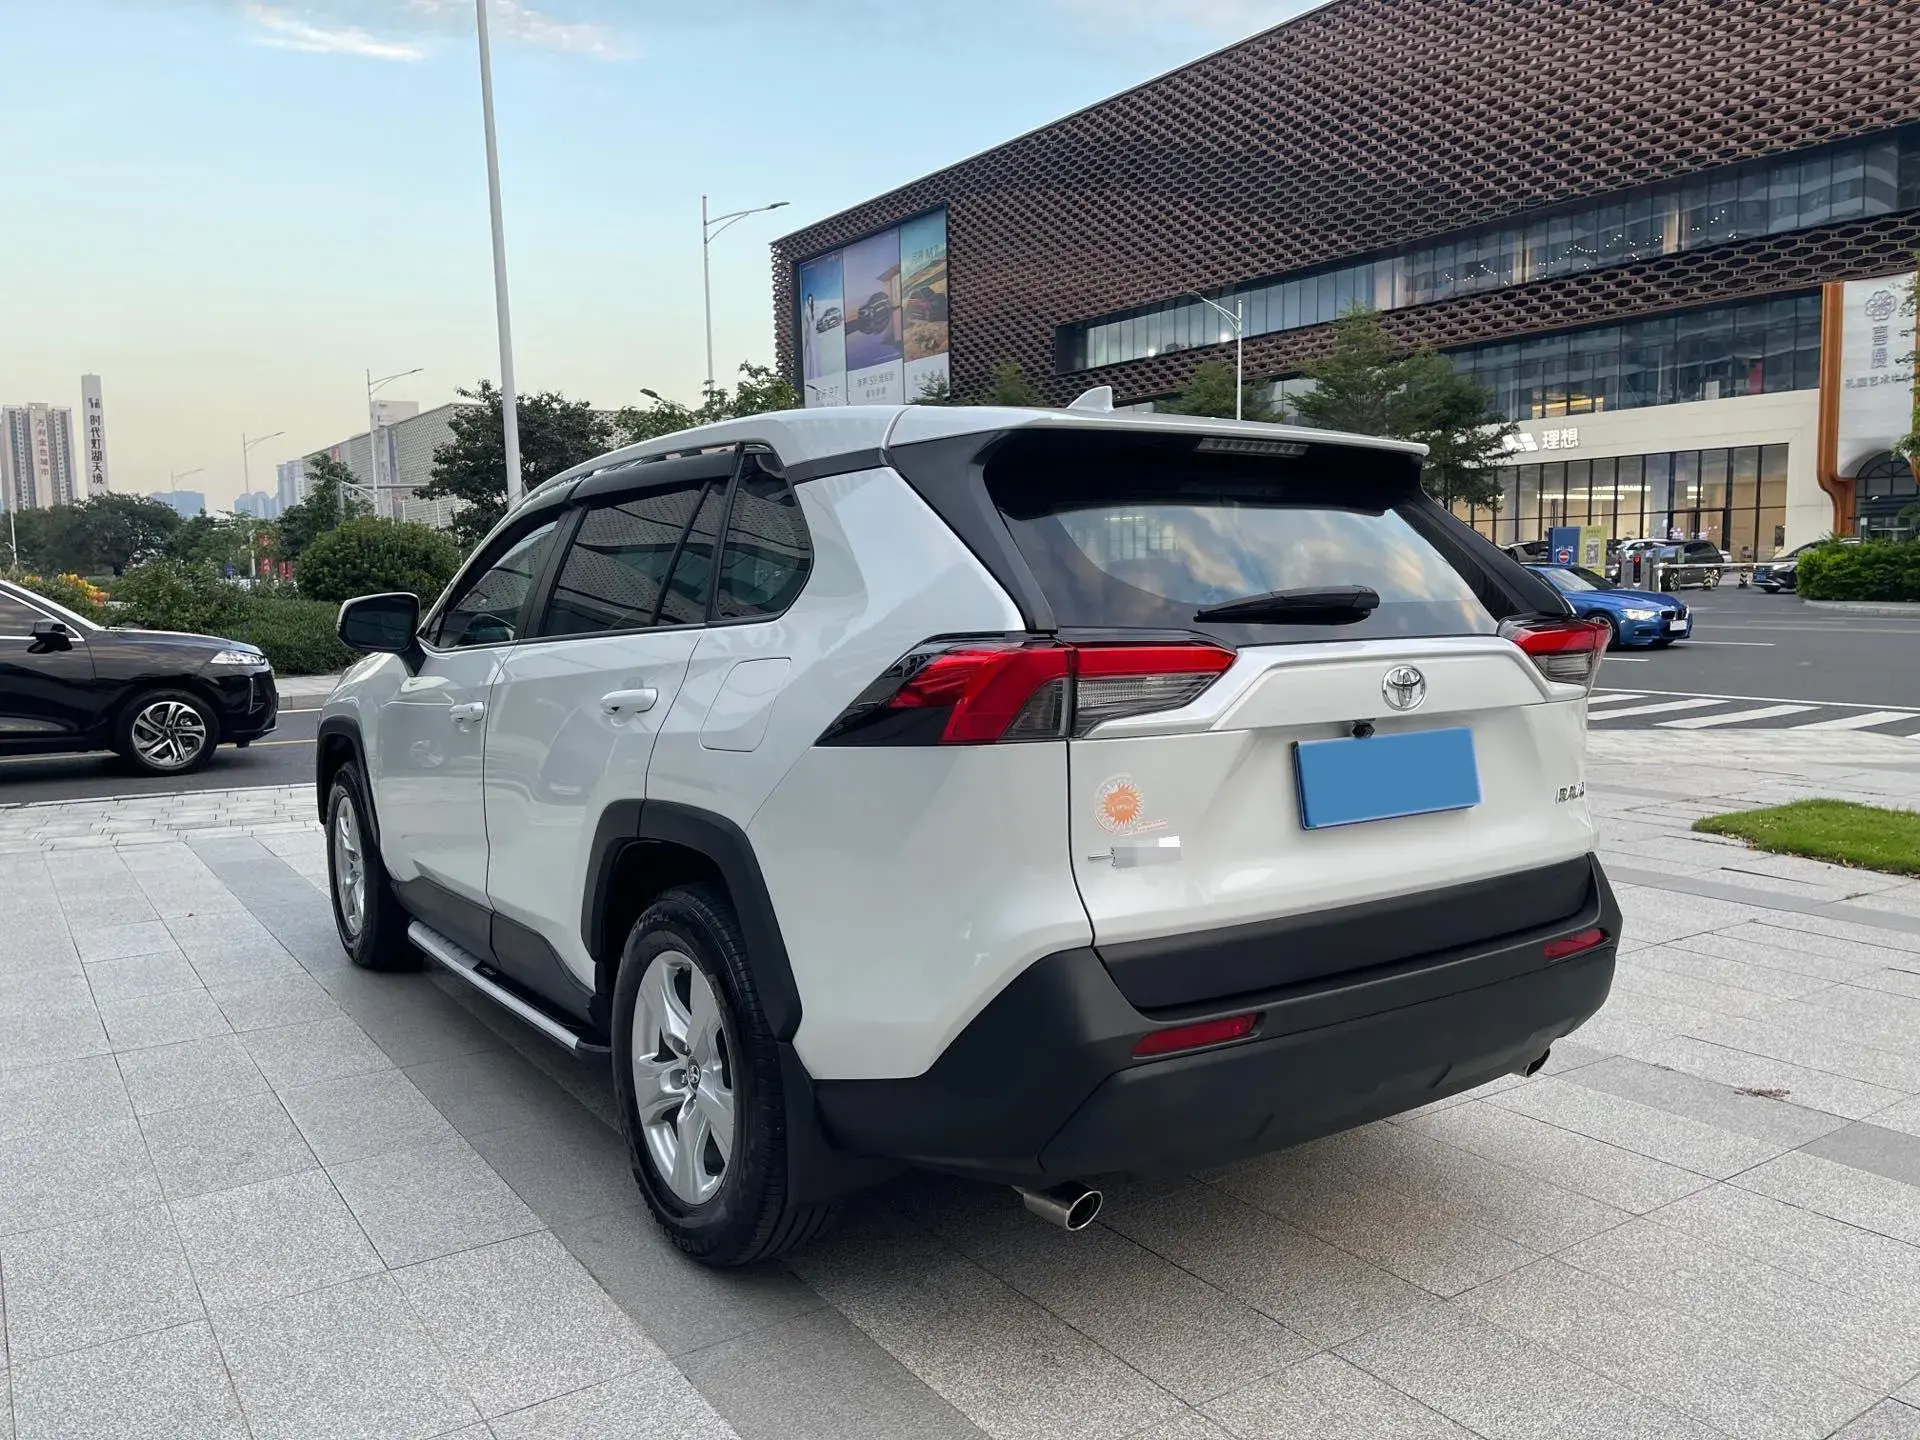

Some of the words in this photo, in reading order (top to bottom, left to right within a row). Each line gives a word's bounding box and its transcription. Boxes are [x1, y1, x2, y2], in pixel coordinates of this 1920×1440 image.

[89, 414, 104, 485] 时代灯湖天境
[1542, 427, 1579, 450] 理想
